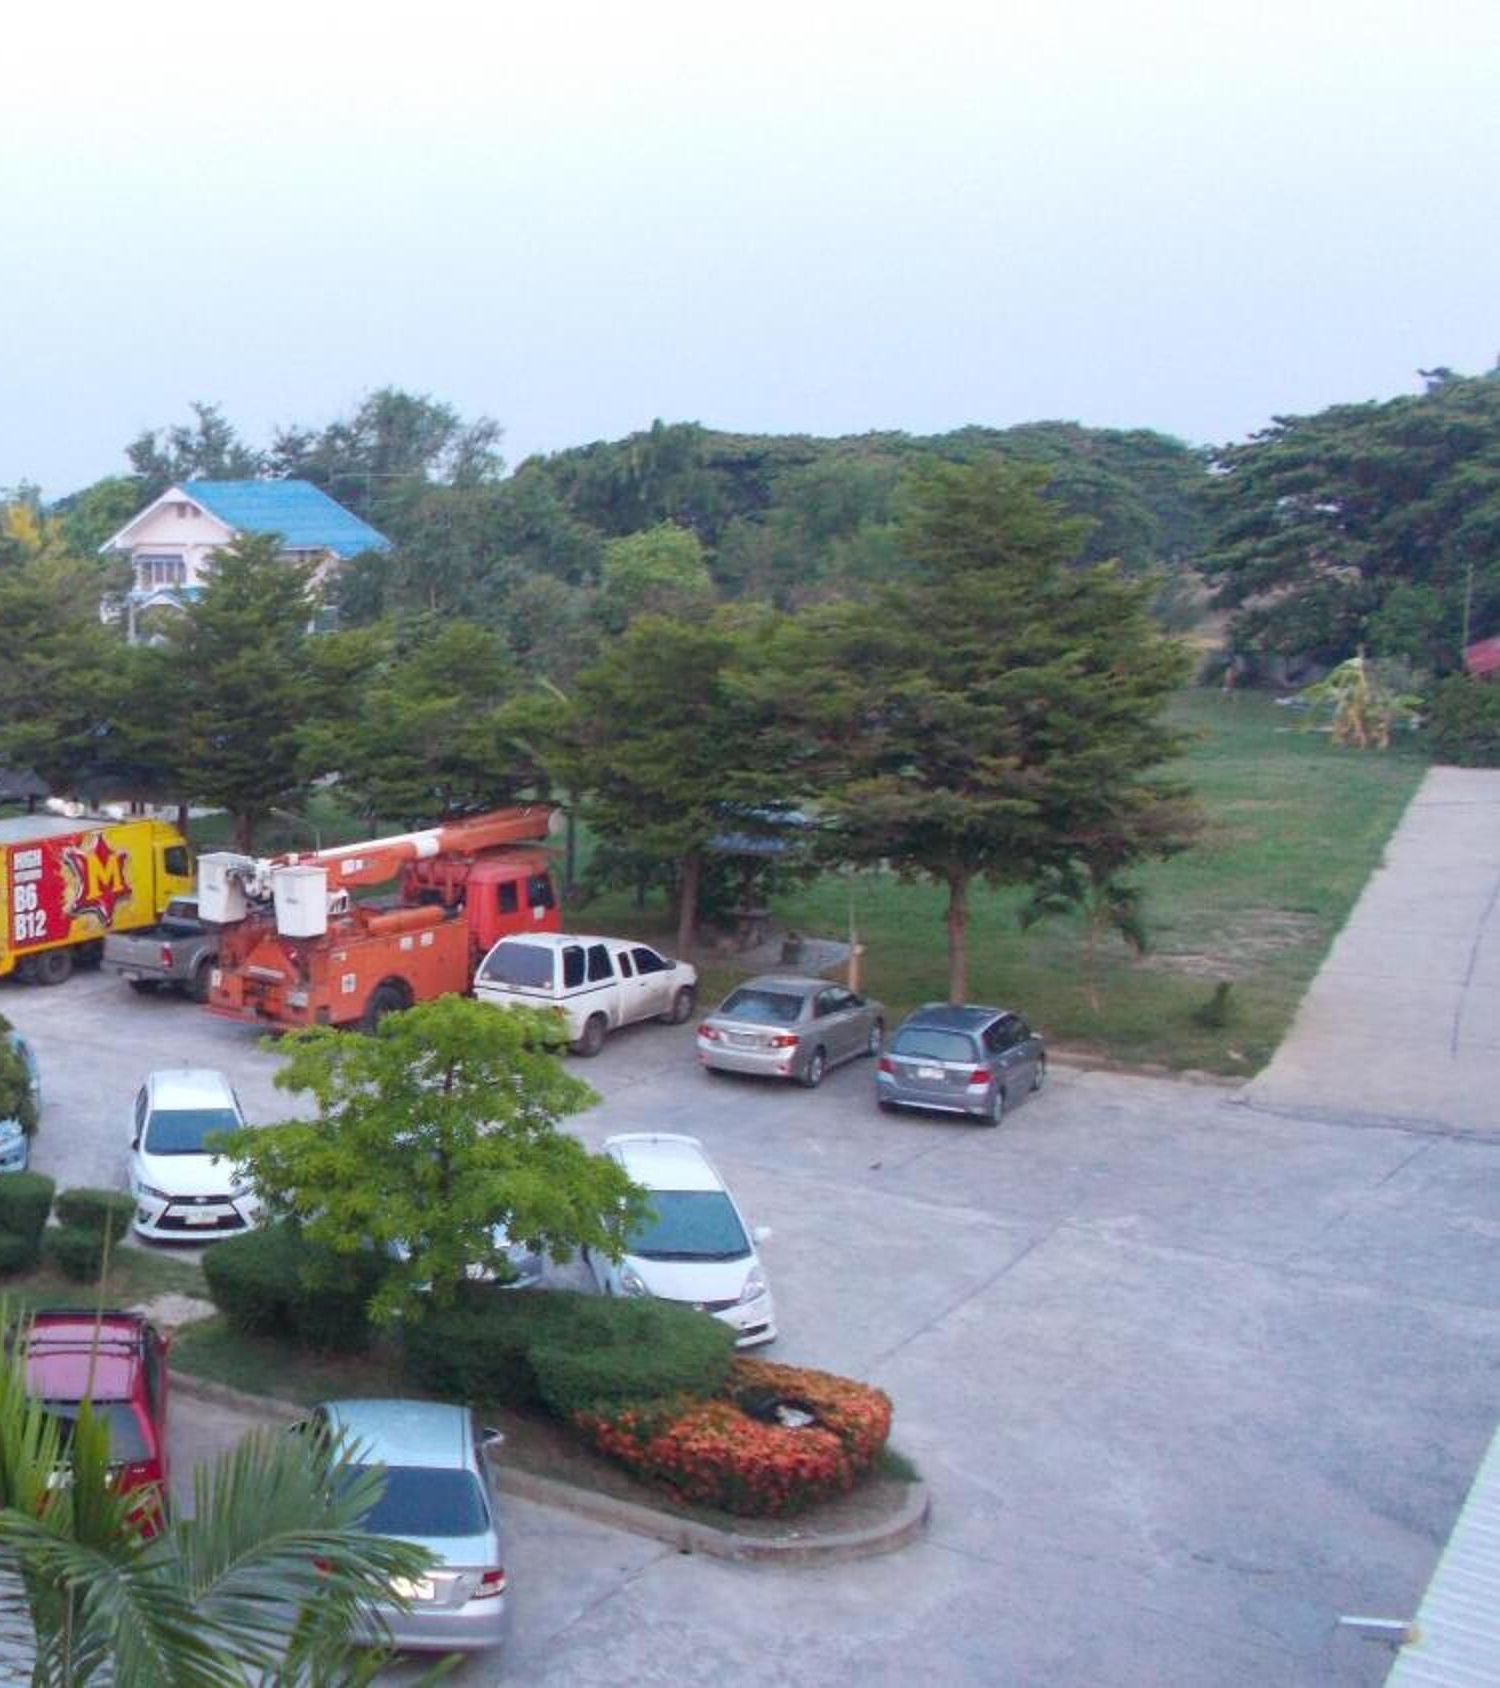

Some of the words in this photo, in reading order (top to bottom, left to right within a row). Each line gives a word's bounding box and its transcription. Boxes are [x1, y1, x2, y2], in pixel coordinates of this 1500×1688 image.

[87, 853, 124, 899] M
[14, 883, 37, 912] B6
[15, 909, 47, 940] B12
